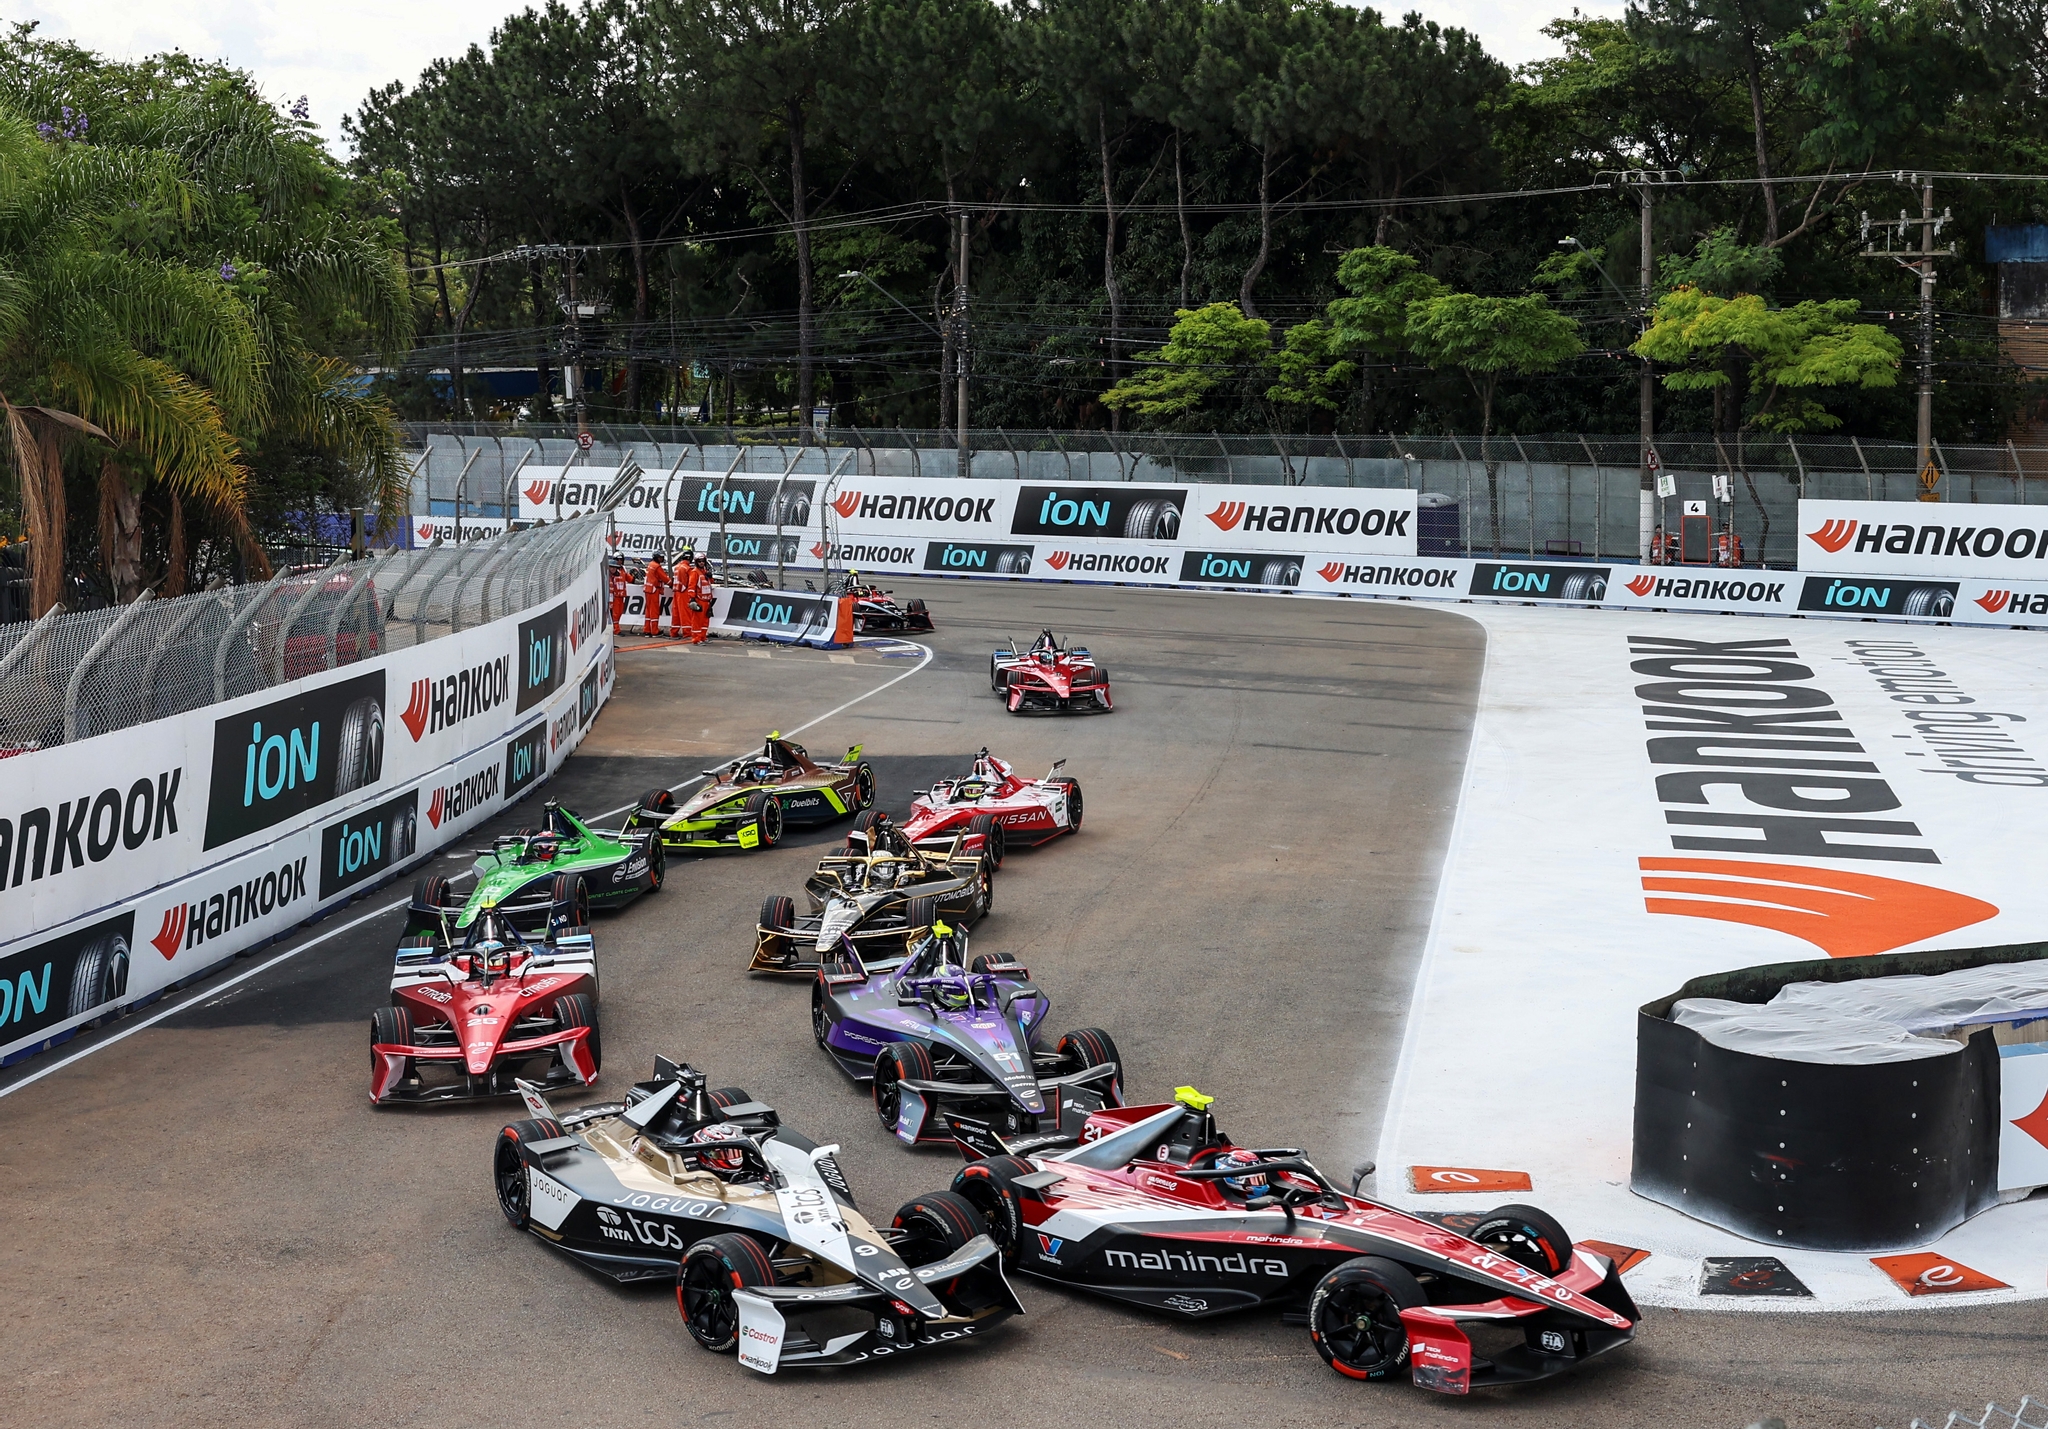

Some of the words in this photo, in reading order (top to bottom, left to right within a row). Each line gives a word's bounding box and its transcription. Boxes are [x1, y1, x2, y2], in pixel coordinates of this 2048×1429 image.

[549, 481, 663, 509] HANOK
[697, 481, 755, 515] iON
[859, 493, 996, 523] HANKOOK
[1690, 502, 1700, 513] 4
[1039, 491, 1111, 526] iON
[1243, 505, 1412, 537] HANKOOK
[941, 544, 988, 567] iON
[1068, 552, 1170, 575] HANKOOK
[1199, 553, 1251, 578] iON
[1342, 564, 1458, 588] HANKOOK
[1492, 565, 1551, 593] iON
[1654, 578, 1786, 603] HANKOOK
[1824, 579, 1891, 608] iON
[746, 595, 793, 626] iON
[528, 629, 551, 689] iON
[1830, 640, 1976, 705] emotion
[429, 653, 510, 735] HANKOOK
[1626, 635, 1943, 865] HANKOOK
[1891, 709, 2048, 787] driving
[243, 720, 320, 807] iON
[513, 741, 532, 784] iON
[443, 762, 500, 824] HANKOOK
[790, 797, 820, 810] Duelbits
[338, 820, 383, 878] iON
[185, 855, 308, 951] HANKOOK
[931, 882, 975, 903] UTOMOBILES
[466, 1017, 498, 1028] 25
[992, 1052, 1021, 1061] 51
[959, 1123, 987, 1135] HANKOOK
[1084, 1123, 1103, 1142] 21
[613, 1192, 728, 1219] JAGUAR
[599, 1225, 634, 1243] TATA
[626, 1211, 684, 1250] tcs
[1246, 1235, 1304, 1245] mahindra
[854, 1244, 879, 1257] 9
[1104, 1248, 1289, 1278] mahindra
[877, 1268, 910, 1282] ABB
[895, 1301, 910, 1314] DOW
[748, 1328, 778, 1345] Castrol
[880, 1320, 894, 1334] FIA
[1542, 1334, 1564, 1347] FIA
[1424, 1352, 1459, 1363] mahindra
